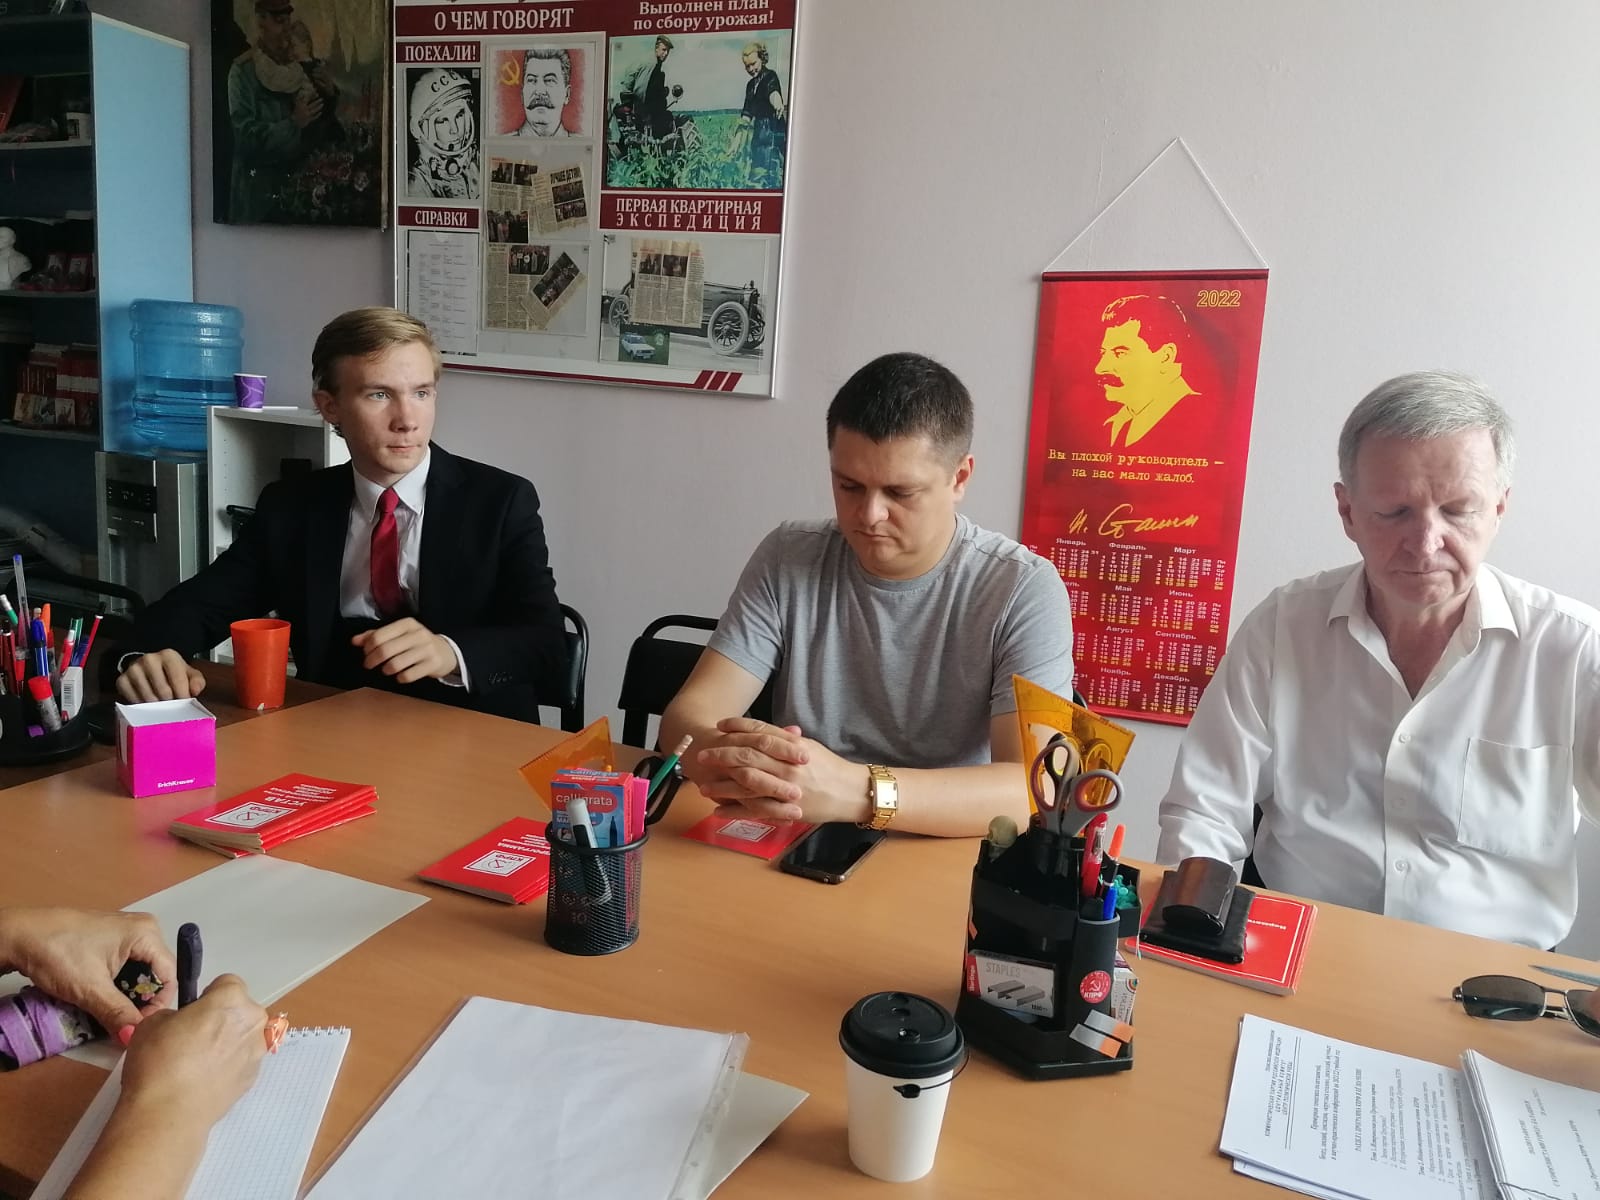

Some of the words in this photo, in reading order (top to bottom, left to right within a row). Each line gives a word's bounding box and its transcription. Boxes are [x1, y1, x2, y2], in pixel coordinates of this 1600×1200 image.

[639, 0, 723, 15] Выполнен
[728, 0, 769, 10] план
[434, 11, 446, 30] О
[451, 11, 488, 31] ЧЕМ
[493, 7, 574, 30] ГОВОРЯТ
[633, 19, 652, 30] по
[656, 15, 701, 31] сбору
[705, 10, 773, 30] урожая!
[405, 45, 476, 61] ПОЕХАЛИ!
[616, 198, 667, 213] ПЕРВАЯ
[671, 200, 762, 215] КВАРТИРНАЯ
[415, 210, 467, 226] СПРАВКИ
[617, 213, 761, 231] ЭКСПЕДИЦИЯ
[1197, 290, 1242, 307] 2022
[1048, 449, 1066, 460] Вы
[1072, 452, 1112, 463] плохой
[1117, 454, 1209, 467] руководитель
[1072, 468, 1087, 477] на
[1092, 469, 1114, 479] вас
[1119, 471, 1150, 481] мало
[1155, 472, 1195, 483] жалоб.
[1056, 538, 1086, 547] Январь
[1109, 543, 1146, 551] Февраль
[1174, 547, 1197, 555] Март
[1106, 626, 1133, 634] Август
[1155, 631, 1197, 640] Сентябрь
[1100, 667, 1132, 676] Ноябрь
[1153, 673, 1190, 682] Декабрь
[264, 796, 308, 806] УСТАВ
[986, 962, 1021, 977] STAPLES
[1084, 991, 1103, 999] КПРФ
